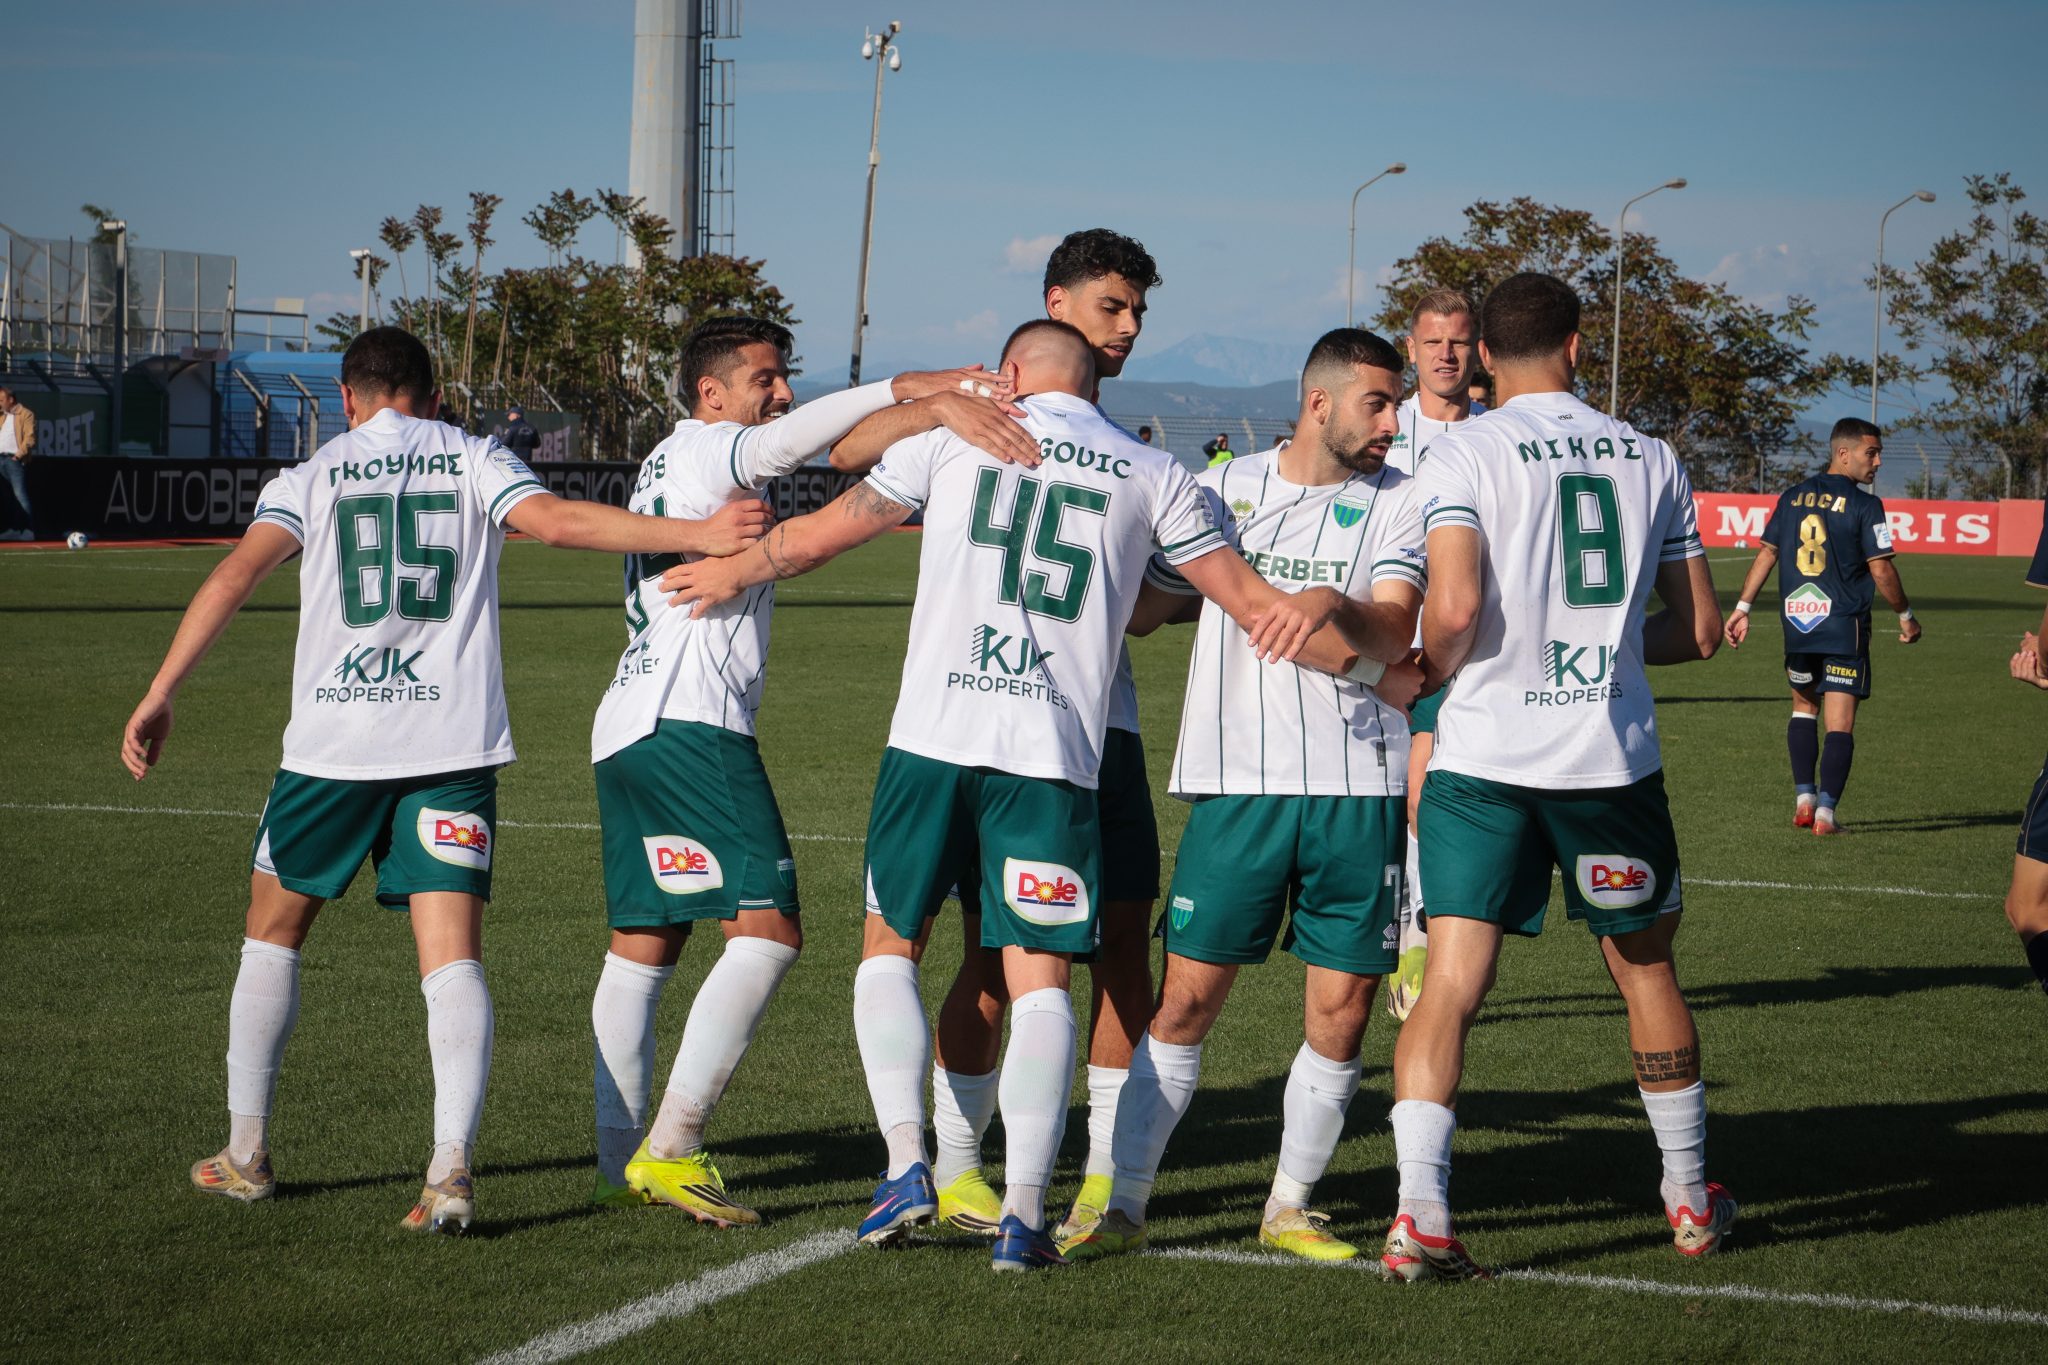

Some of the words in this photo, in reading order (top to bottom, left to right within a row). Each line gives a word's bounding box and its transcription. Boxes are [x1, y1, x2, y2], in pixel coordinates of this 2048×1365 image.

[36, 412, 95, 456] RBET
[1518, 436, 1642, 463] ΝΙΚΑΣ
[330, 453, 463, 487] ΓΚΟΥΜΑΣ
[1034, 438, 1131, 479] GOVIC
[1791, 492, 1846, 513] JOCA
[1556, 472, 1628, 609] 8
[1716, 506, 1990, 545] MRIS
[333, 490, 459, 628] 85
[968, 464, 1112, 624] 45
[1796, 513, 1826, 577] 8
[334, 643, 425, 684] KJK
[316, 685, 441, 704] PROPERTIES
[948, 672, 1068, 710] PROPERTIES
[1525, 682, 1622, 707] PROPERES
[435, 820, 488, 850] Dole
[657, 847, 708, 873] Dole
[1592, 864, 1648, 887] Dole
[1017, 872, 1078, 902] Dole
